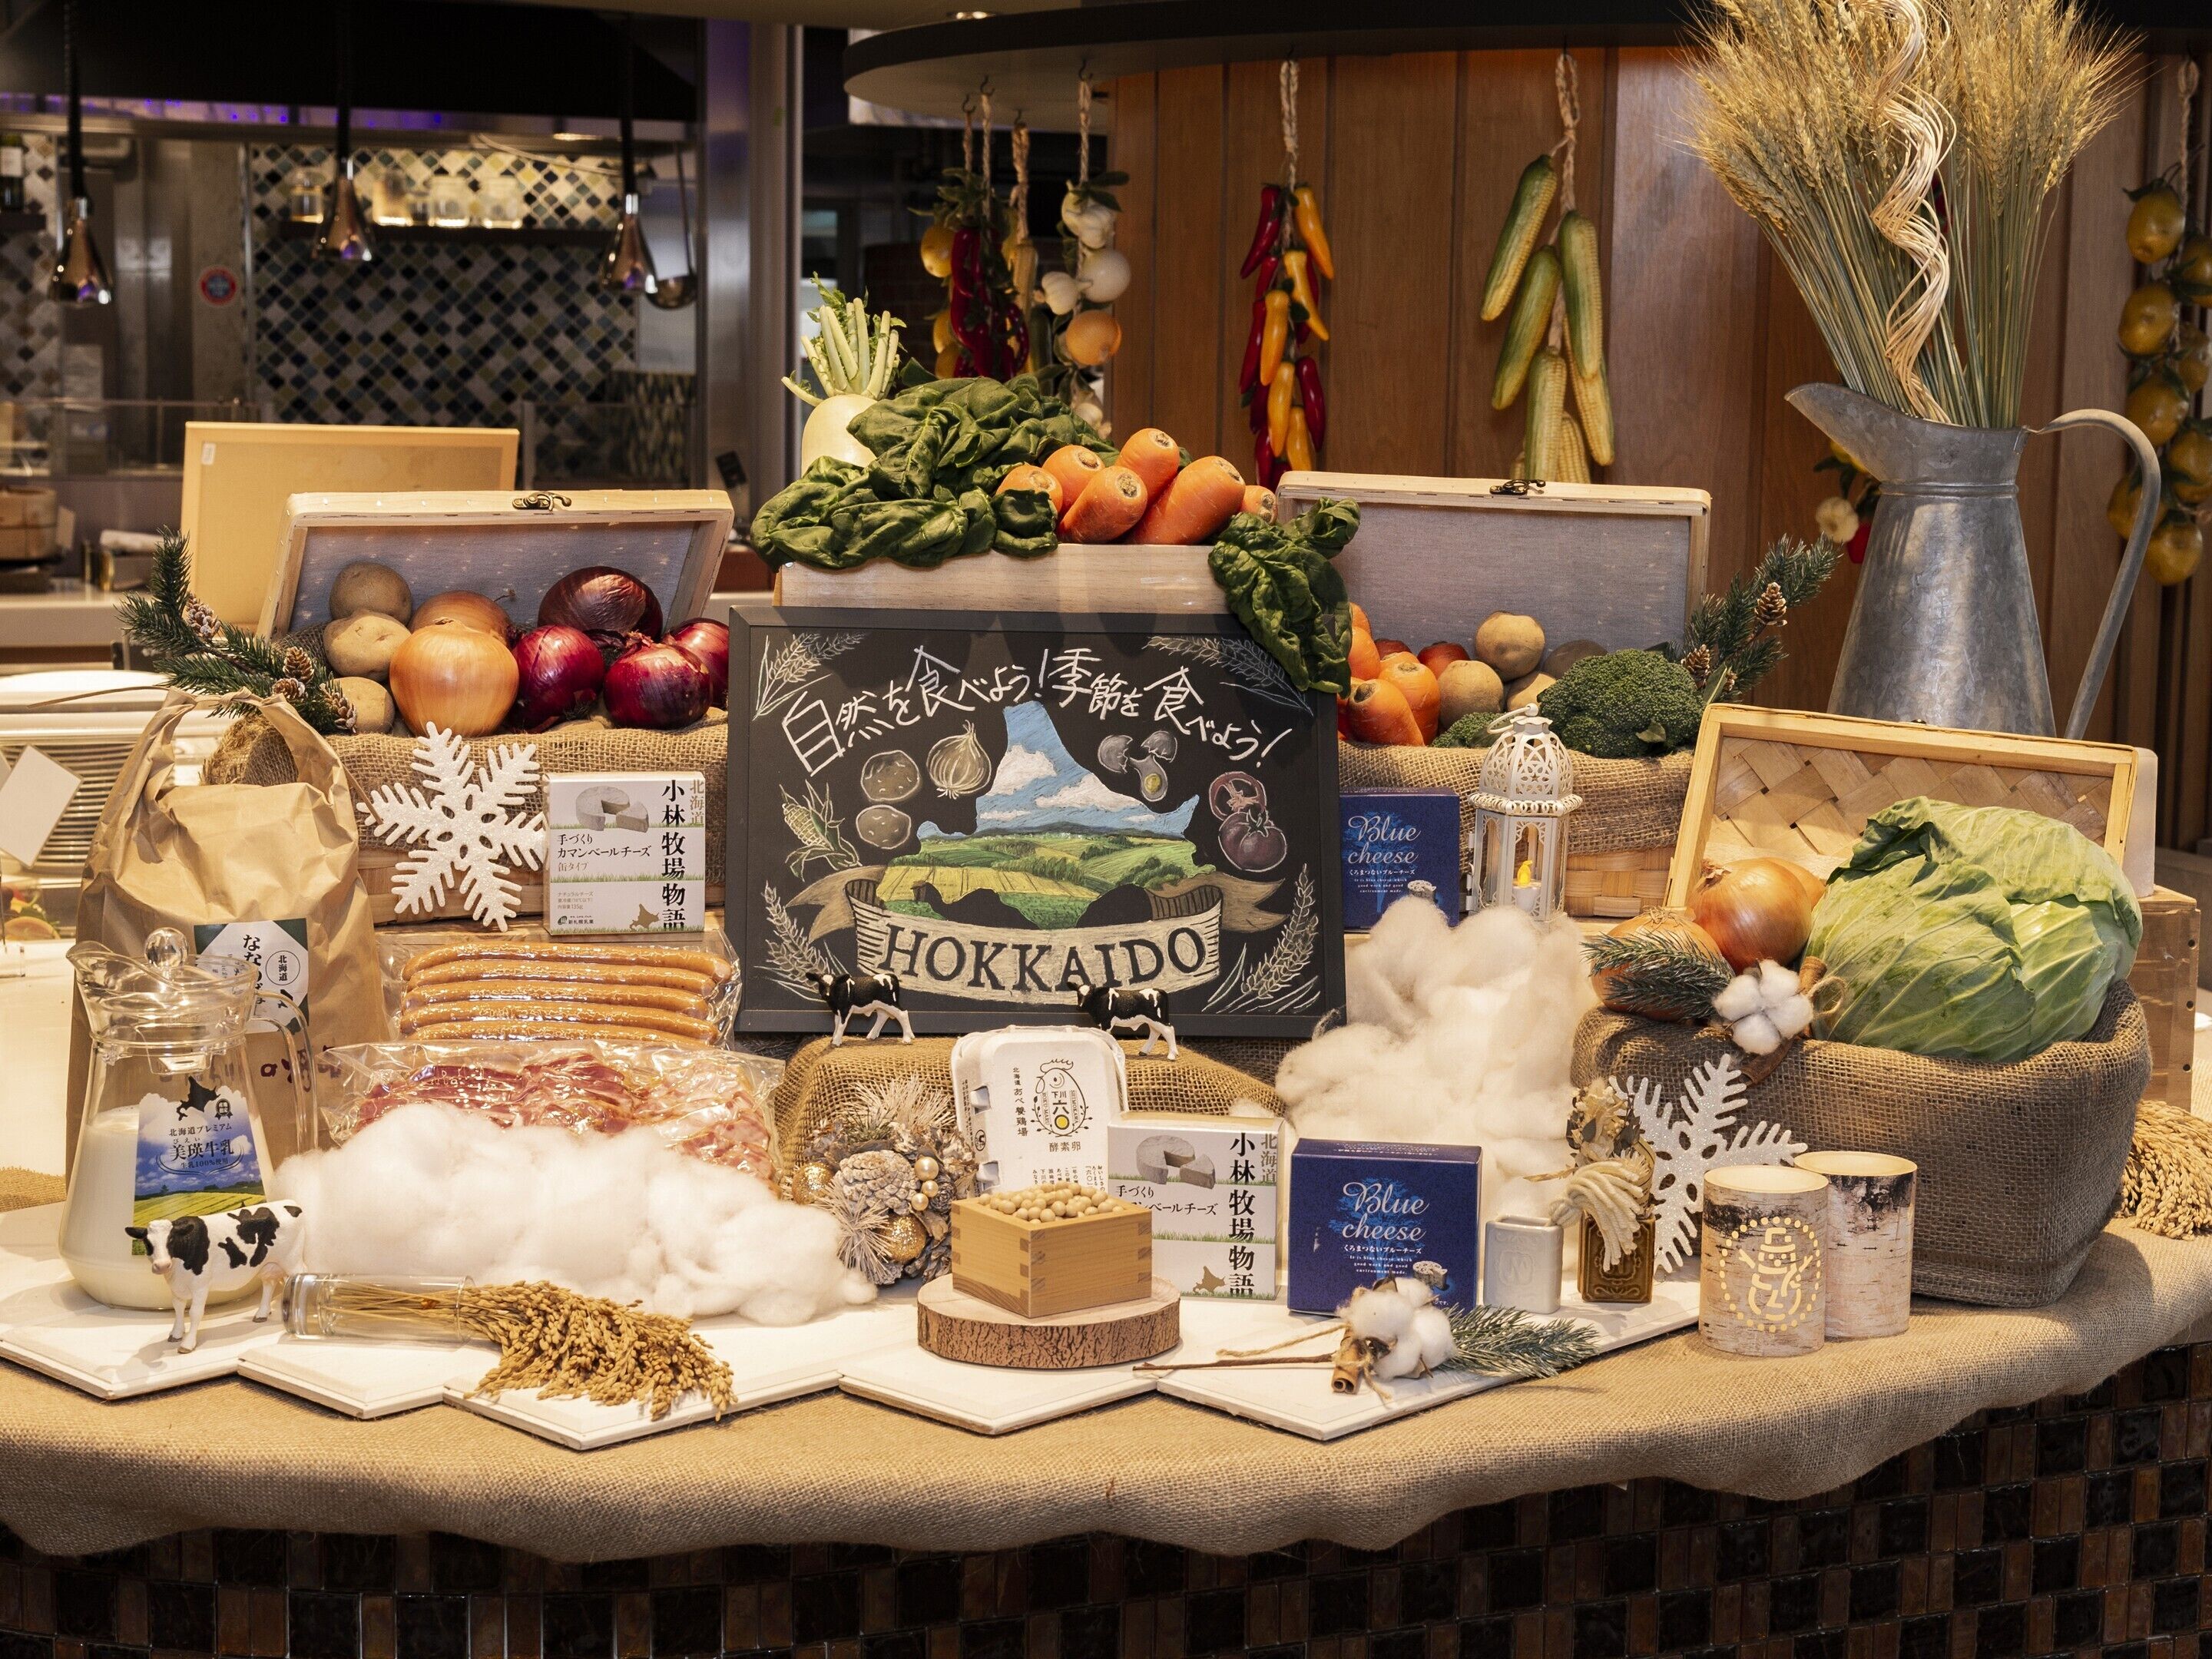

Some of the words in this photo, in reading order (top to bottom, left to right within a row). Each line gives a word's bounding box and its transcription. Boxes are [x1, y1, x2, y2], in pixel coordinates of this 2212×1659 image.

[690, 779, 704, 826] 北海道
[558, 833, 593, 845] 手づくり
[1348, 815, 1422, 842] Blue
[558, 846, 652, 858] カマンベールチーズ
[661, 779, 686, 930] 小林牧場物語
[1347, 842, 1419, 864] cheese
[558, 862, 588, 873] 缶タイプ
[278, 955, 288, 982] 北海道
[880, 922, 1208, 992] HOKKAIDO
[169, 1123, 233, 1137] 北海道プレミアム
[171, 1138, 234, 1162] 美瑛牛乳
[1048, 1141, 1081, 1152] 酵素卵
[1261, 1133, 1277, 1185] 北海道
[1115, 1184, 1154, 1198] 手づくり
[1343, 1181, 1430, 1215] Blue
[1228, 1132, 1256, 1297] 小林牧場物語
[1342, 1213, 1426, 1241] cheese
[1343, 1244, 1422, 1254] くろまつないブルーチーズ
